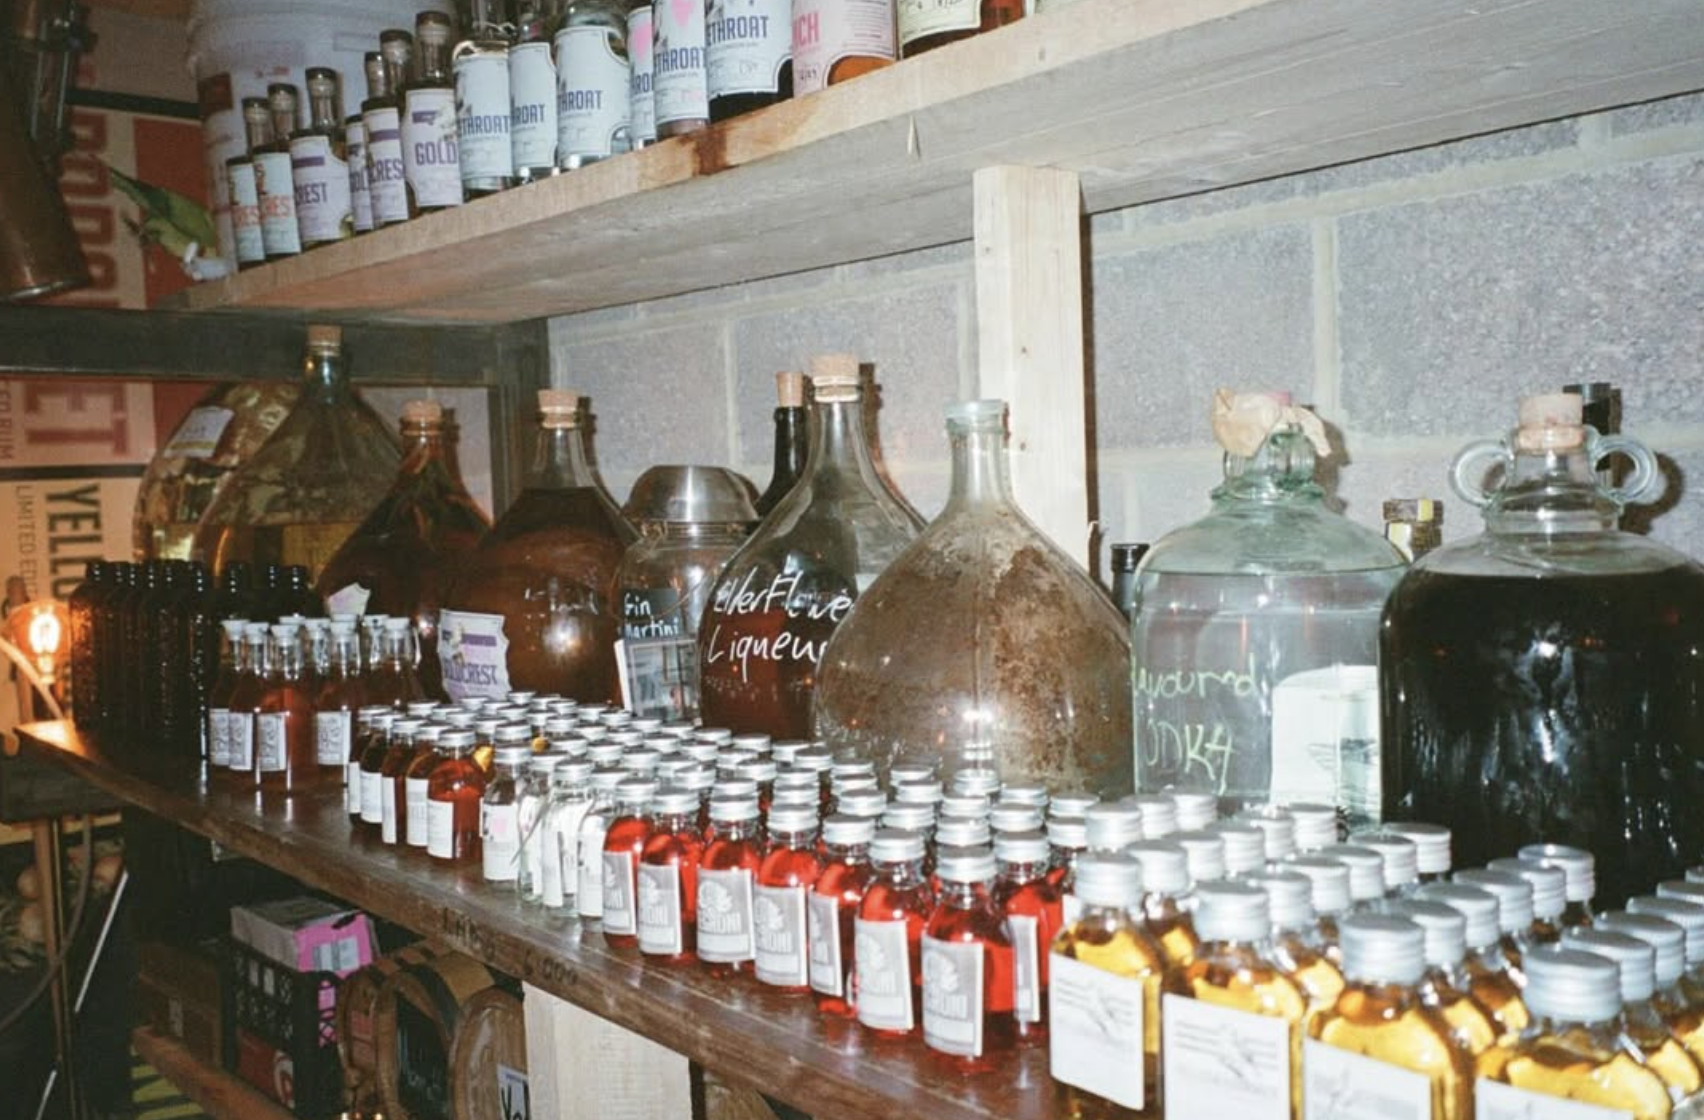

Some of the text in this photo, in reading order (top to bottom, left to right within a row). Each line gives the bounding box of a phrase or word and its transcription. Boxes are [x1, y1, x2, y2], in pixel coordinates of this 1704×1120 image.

[414, 140, 459, 167] GOLD
[16, 484, 37, 554] LIMITED
[624, 593, 651, 616] Gin
